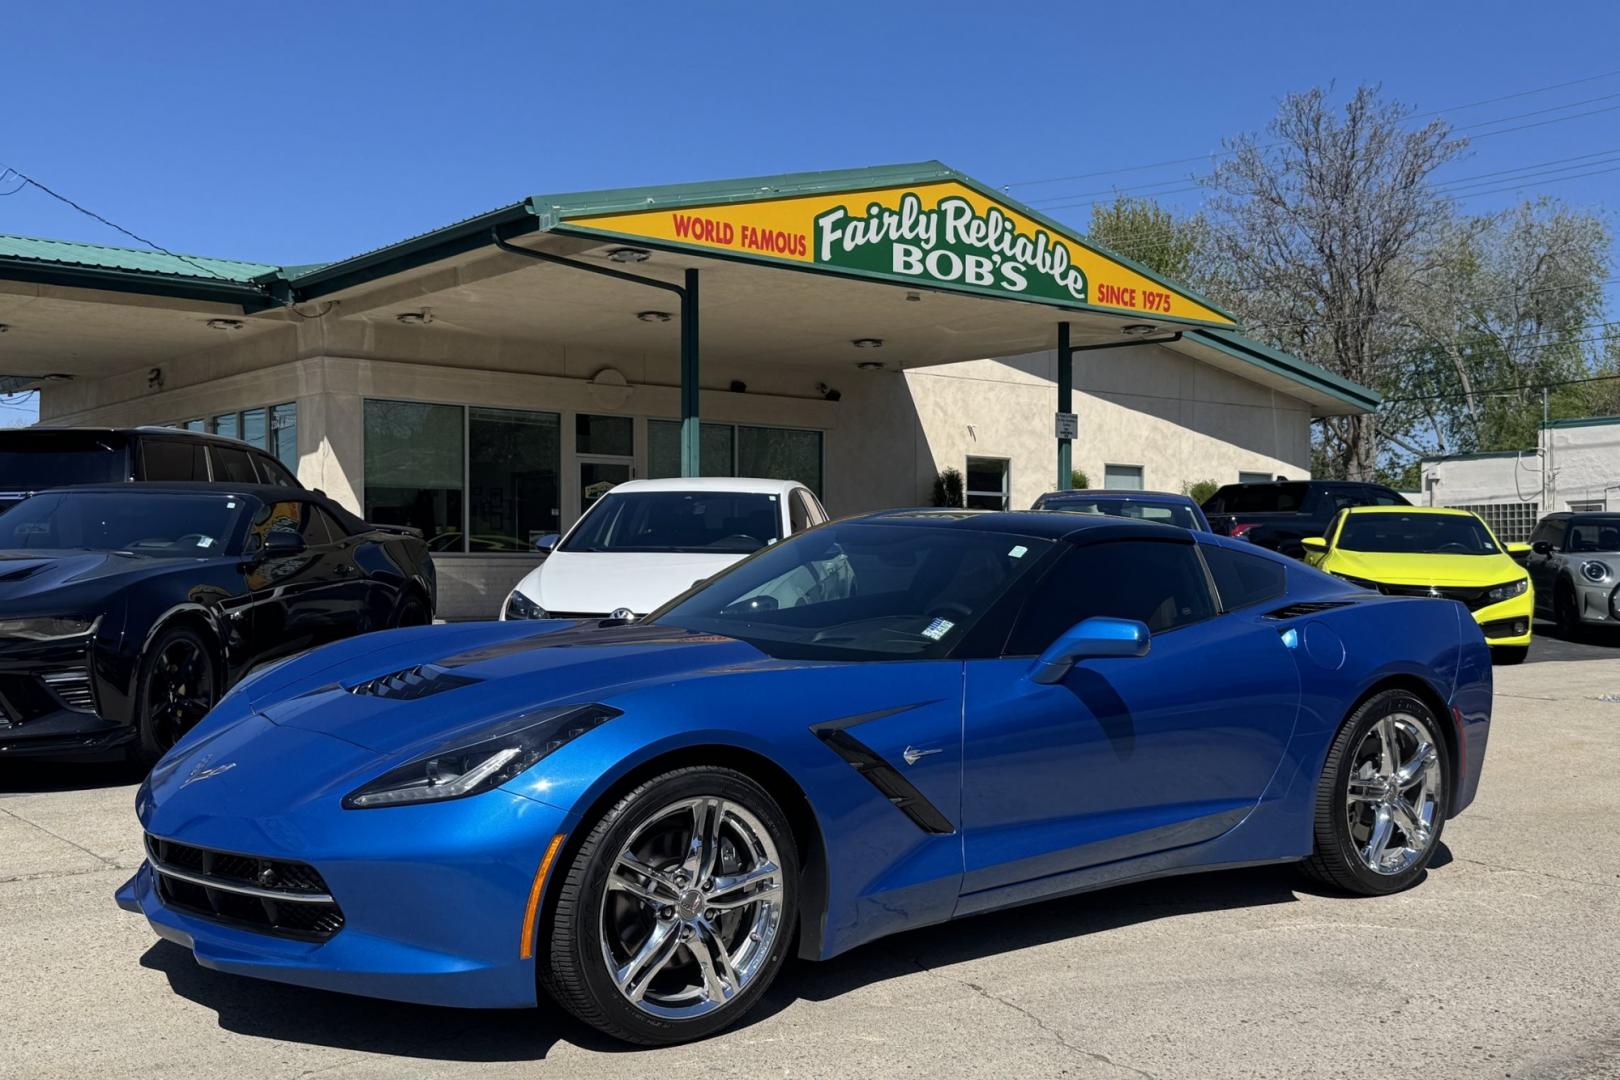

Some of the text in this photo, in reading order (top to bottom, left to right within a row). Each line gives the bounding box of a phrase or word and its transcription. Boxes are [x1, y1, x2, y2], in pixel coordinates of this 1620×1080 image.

[672, 213, 807, 257] WORLD FAMOUS
[818, 196, 1086, 299] Fairly Reliable
[892, 242, 1028, 292] BOB'S
[1097, 283, 1171, 313] SINCE 1975
